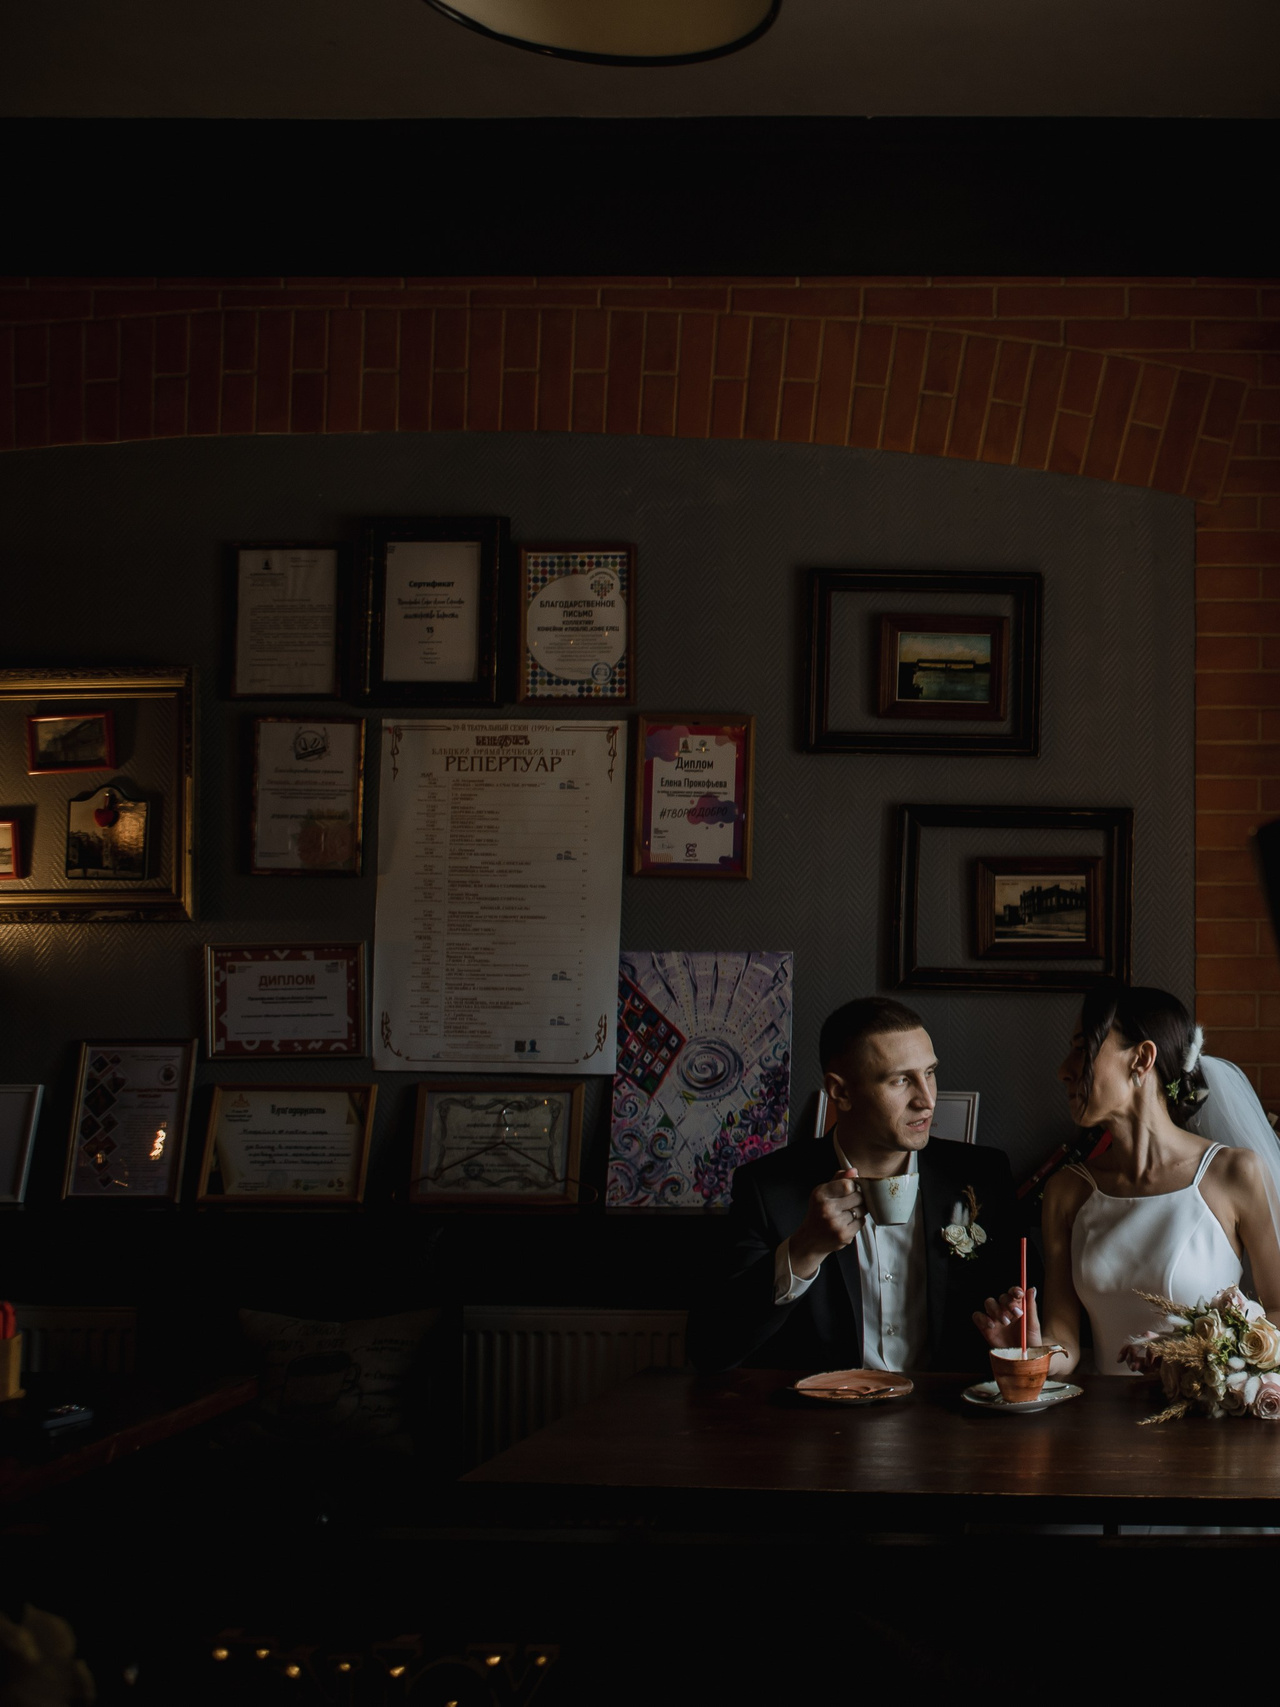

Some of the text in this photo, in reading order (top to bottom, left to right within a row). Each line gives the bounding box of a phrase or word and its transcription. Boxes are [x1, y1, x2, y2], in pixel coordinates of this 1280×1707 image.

[409, 580, 454, 589] Сертификат
[539, 600, 616, 608] БЛАГОДАРСТВЕННОЕ
[510, 724, 528, 732] СЕЗОН
[473, 748, 544, 756] ДРАМАТИЧЕСКИЙ
[446, 756, 562, 773] РЕПЕРТУАР
[675, 757, 714, 770] Диплом
[660, 777, 728, 789] Елена Прокофьева
[659, 806, 728, 820] #ТВОРЮДОБРО
[258, 974, 315, 987] ДИПЛОМ
[271, 1104, 326, 1116] Благодарность
